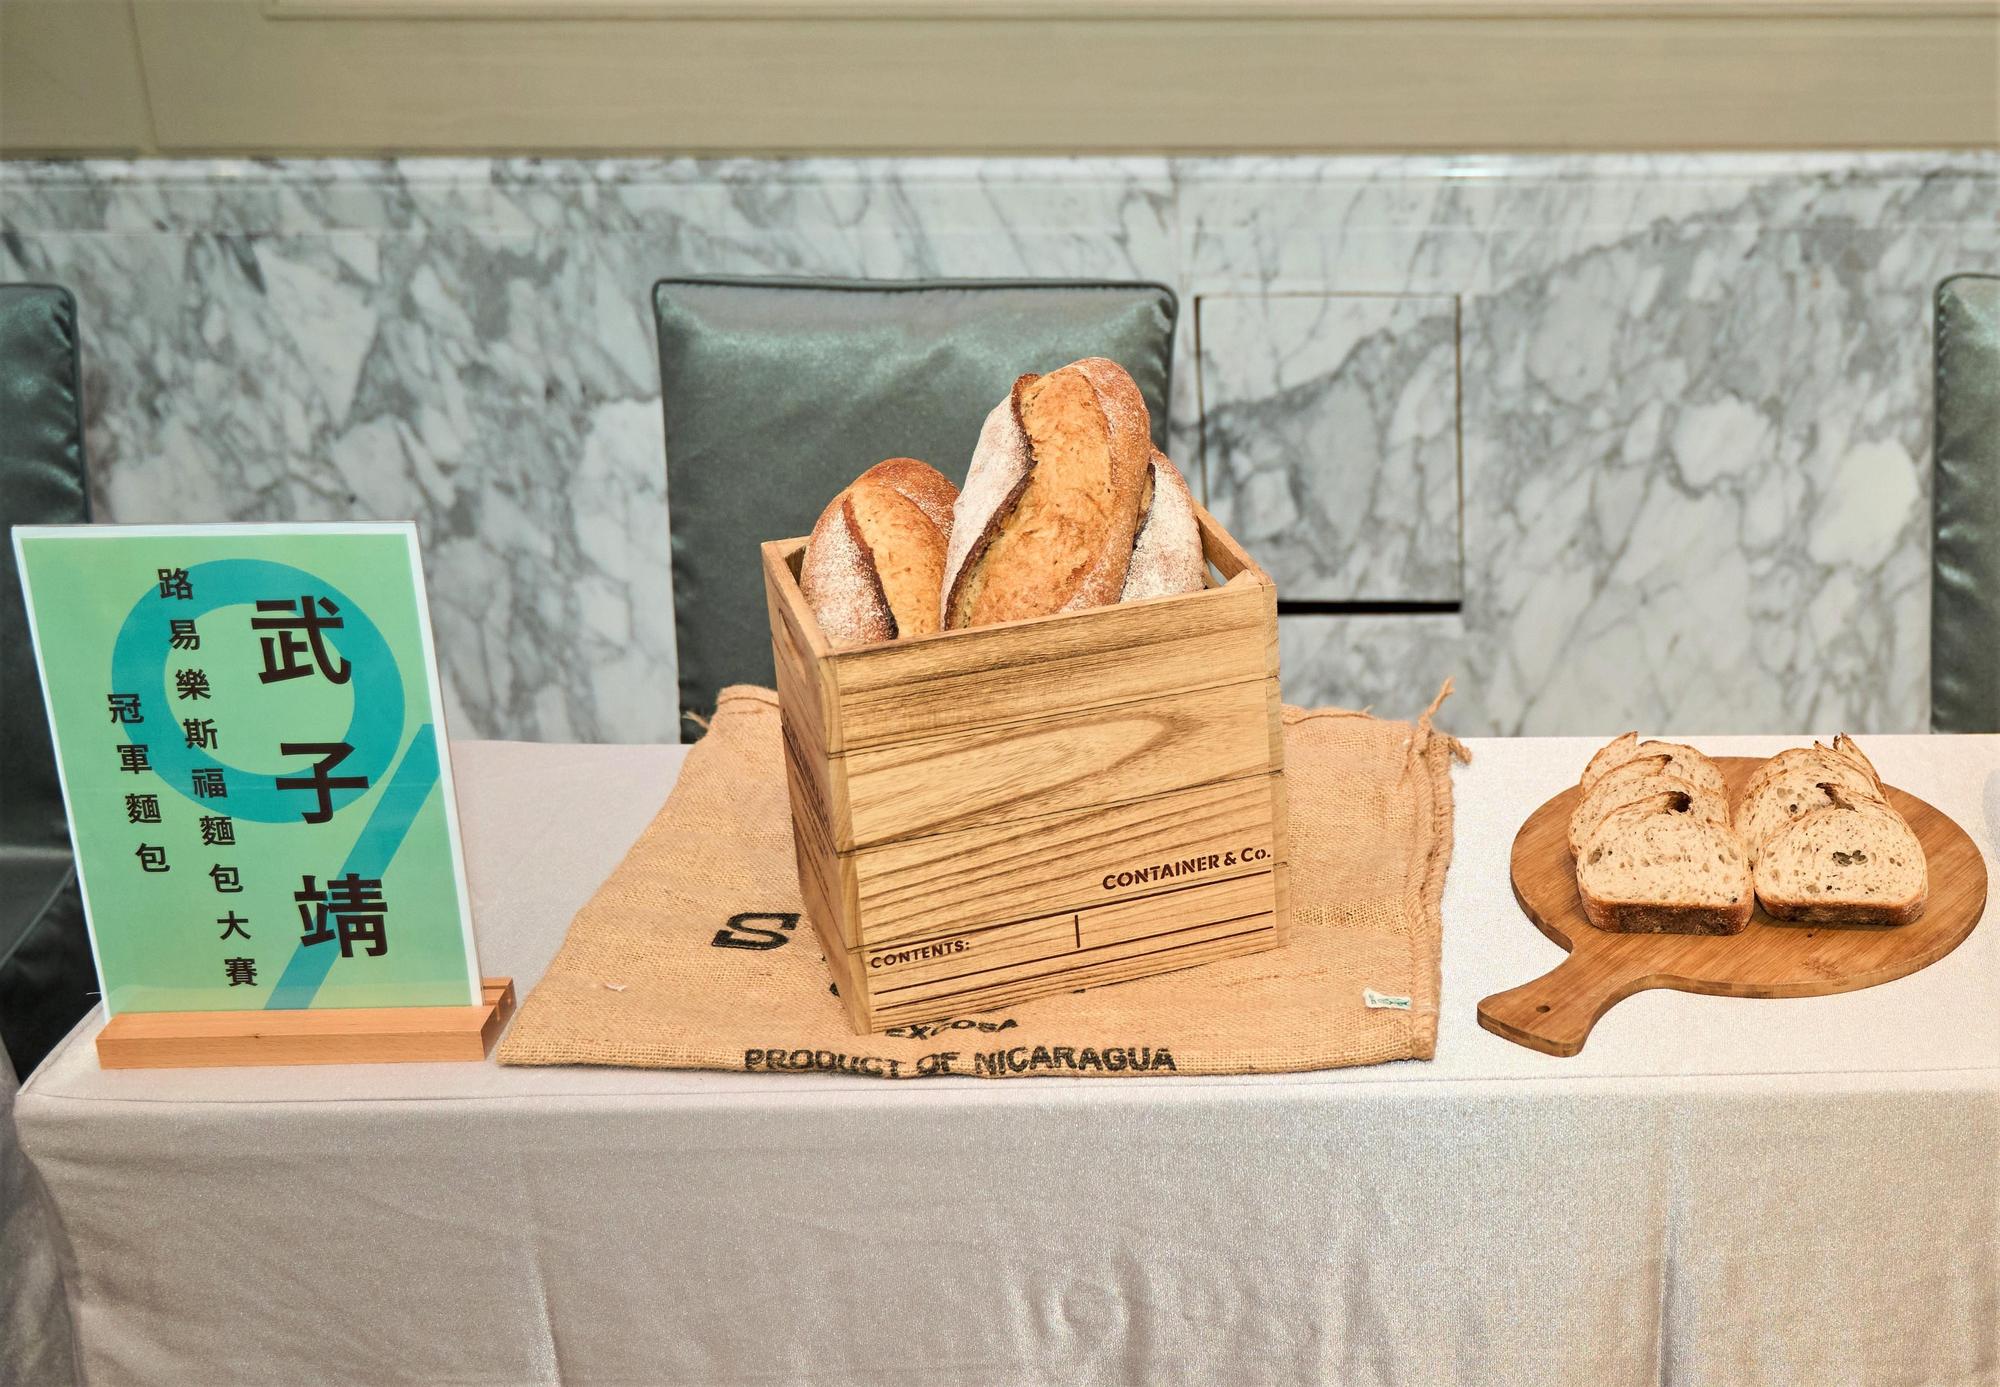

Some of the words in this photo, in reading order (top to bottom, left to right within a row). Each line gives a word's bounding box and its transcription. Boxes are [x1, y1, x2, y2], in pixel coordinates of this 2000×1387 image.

[107, 692, 171, 874] 冠軍麵包
[157, 566, 258, 988] 路易樂斯福麵包大賽
[251, 595, 389, 958] 武子靖
[1102, 854, 1220, 890] CONTAINER
[1223, 851, 1237, 867] &
[1240, 847, 1272, 863] Co.
[870, 939, 971, 969] CONTENTS:
[745, 1048, 906, 1078] PRODUCT
[916, 1051, 960, 1075] OF
[974, 1045, 1177, 1075] NICARAGUA
